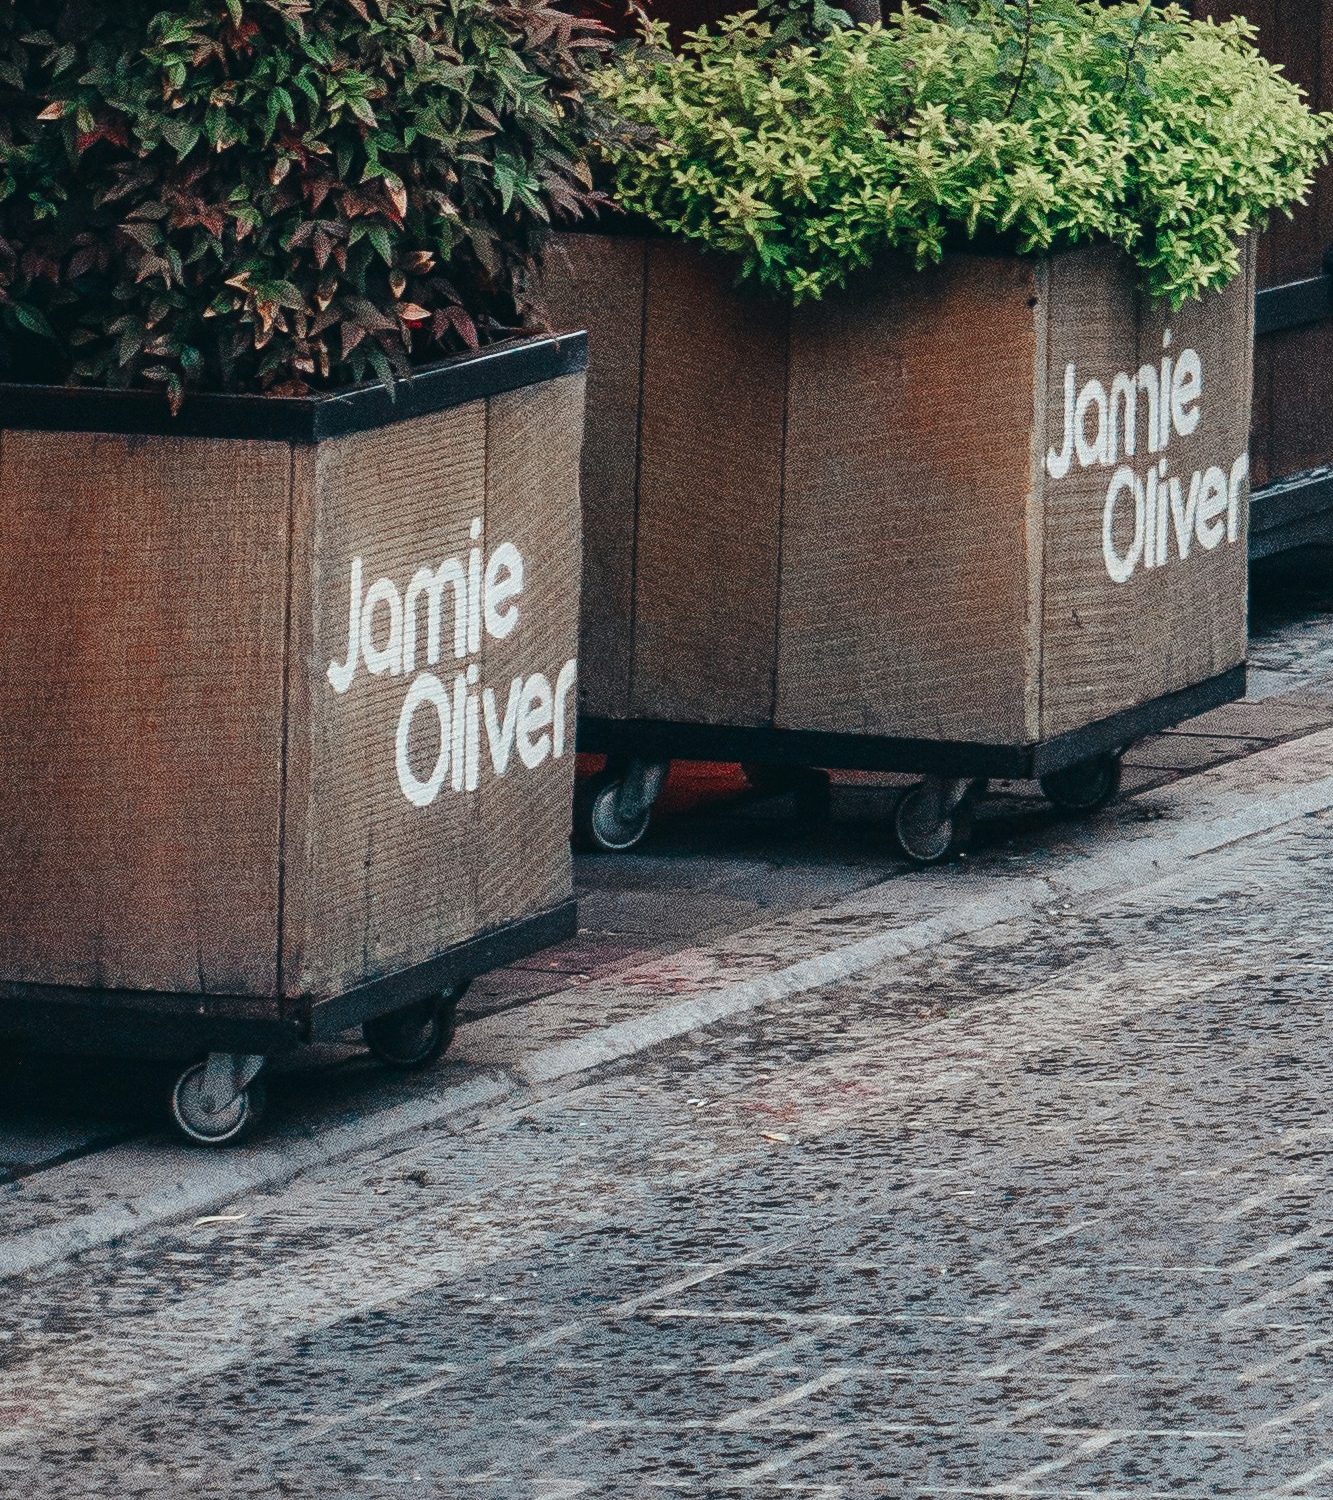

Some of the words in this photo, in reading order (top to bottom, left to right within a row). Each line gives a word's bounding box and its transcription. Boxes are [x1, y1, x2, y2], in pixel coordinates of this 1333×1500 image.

[1046, 328, 1204, 479] Jamie
[1102, 452, 1249, 584] Oliver
[327, 517, 525, 694] Jamie
[395, 658, 577, 808] Oliver
